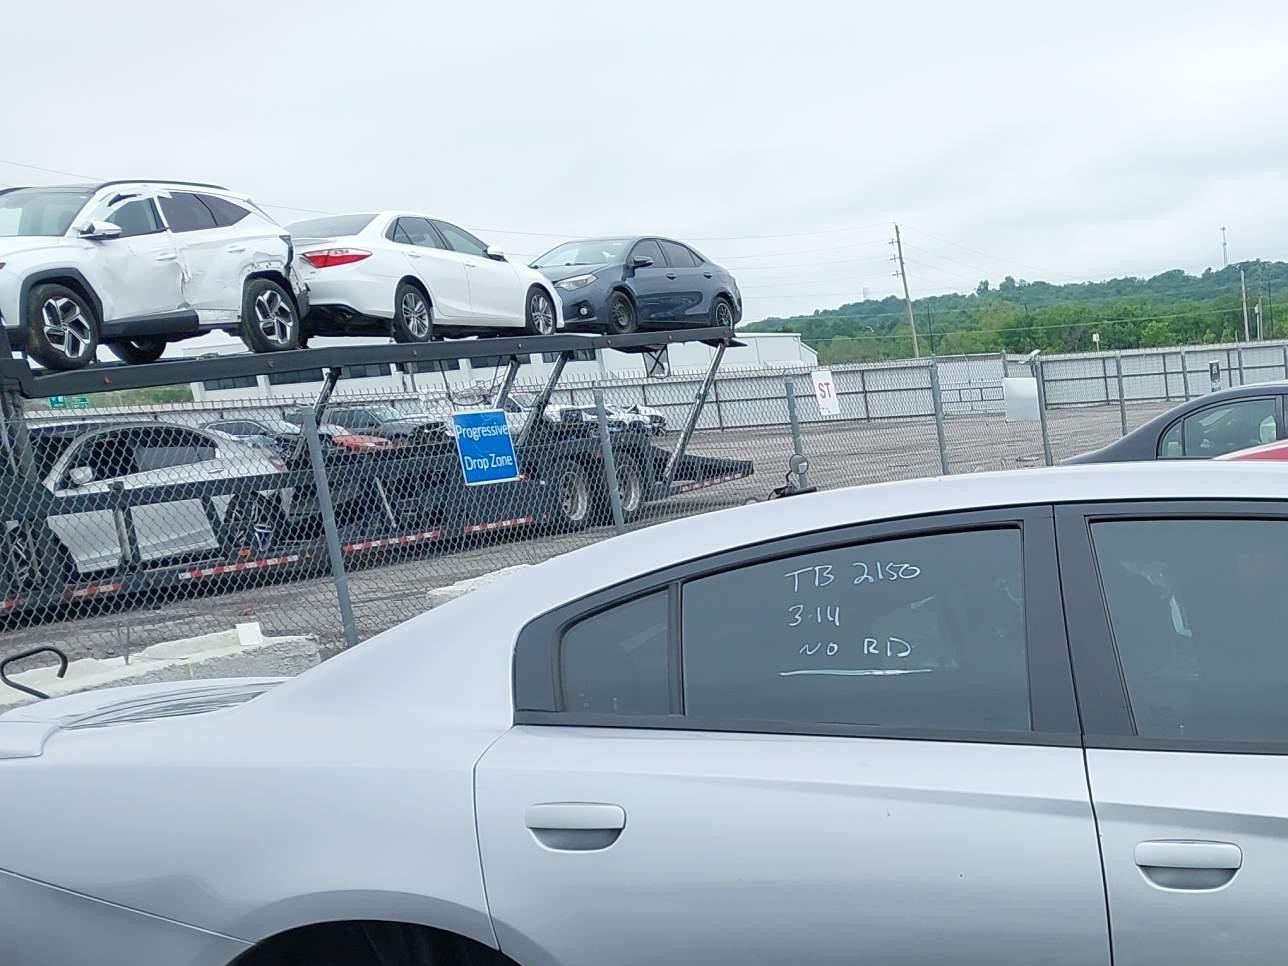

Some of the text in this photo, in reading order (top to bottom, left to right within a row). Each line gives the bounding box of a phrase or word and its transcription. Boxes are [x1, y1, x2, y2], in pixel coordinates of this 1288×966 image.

[455, 422, 509, 440] Progressive
[464, 453, 513, 471] Drop Zone
[784, 561, 921, 592] TB 2150
[799, 637, 911, 657] NO RD
